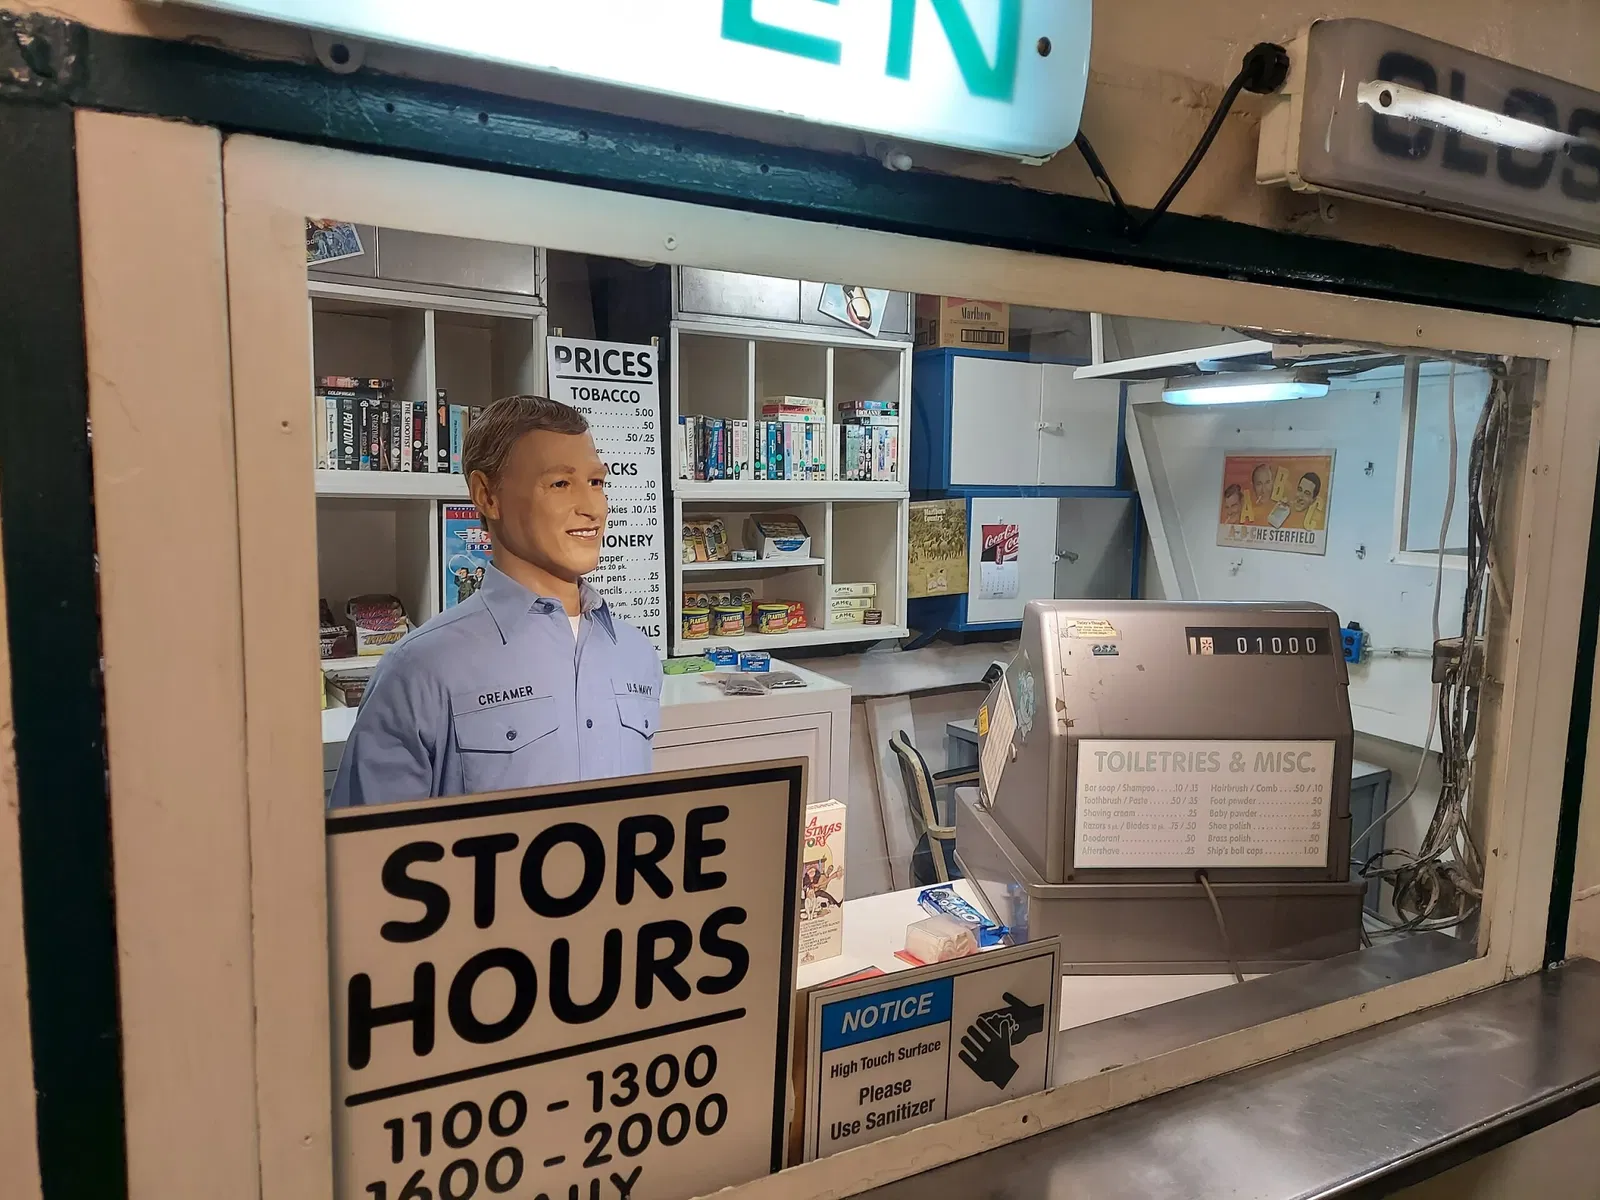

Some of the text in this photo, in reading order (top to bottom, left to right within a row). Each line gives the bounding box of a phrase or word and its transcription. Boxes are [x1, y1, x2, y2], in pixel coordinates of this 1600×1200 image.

[554, 345, 653, 378] PRICES
[570, 387, 641, 403] TOBACCO
[635, 408, 654, 417] 5.00
[343, 412, 353, 446] PATTON
[608, 520, 628, 529] gum
[599, 555, 624, 564] paper
[606, 574, 627, 584] pens
[596, 586, 622, 595] encils
[643, 608, 660, 617] 3.50
[639, 684, 652, 695] NAVY
[478, 685, 534, 706] CREAMER
[1094, 750, 1316, 773] TOILETRIES & MISC.
[1084, 784, 1097, 792] Bar
[1098, 785, 1116, 794] soap
[1122, 784, 1156, 794] Shampoo
[1210, 784, 1248, 792] Hairbrush
[1256, 784, 1278, 792] Comb
[1084, 797, 1122, 805] Toothbrush
[1210, 797, 1227, 805] Foot
[1228, 797, 1257, 806] powder
[1083, 809, 1111, 819] Shaving
[1209, 809, 1228, 819] Baby
[1229, 809, 1257, 819] powder
[806, 816, 817, 828] A
[1229, 822, 1251, 831] polish
[1082, 834, 1120, 842] Deodorant
[1208, 834, 1227, 842] Brass
[1229, 834, 1251, 844] polish
[1082, 847, 1120, 855] Aftershave
[1304, 847, 1319, 855] 1.00
[379, 804, 730, 943] STORE
[347, 905, 750, 1071] HOURS
[841, 992, 934, 1034] NOTICE
[830, 1040, 941, 1079] High Touch Surface
[858, 1077, 912, 1106] Please
[383, 1089, 527, 1164] 1100
[586, 1044, 718, 1112] 1300
[830, 1097, 936, 1141] Use Sanitizer
[582, 1092, 728, 1168] 2000
